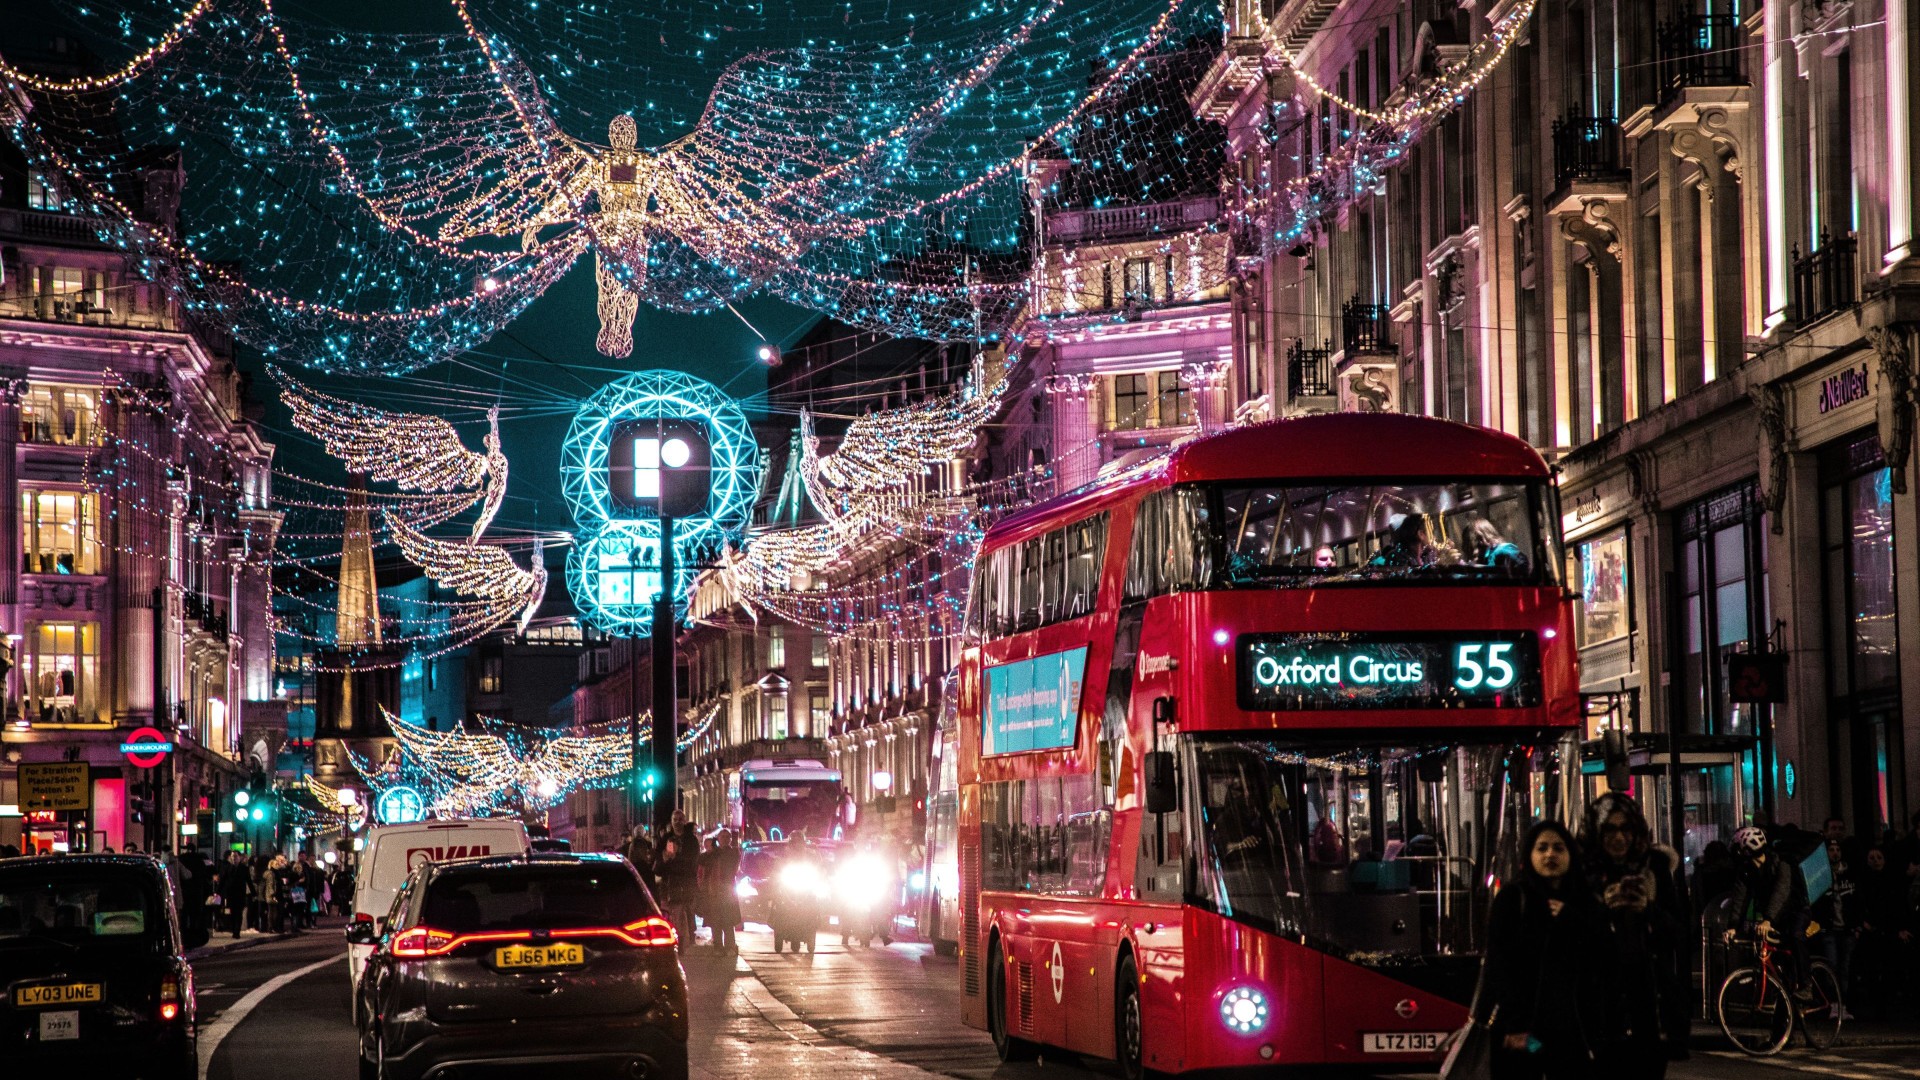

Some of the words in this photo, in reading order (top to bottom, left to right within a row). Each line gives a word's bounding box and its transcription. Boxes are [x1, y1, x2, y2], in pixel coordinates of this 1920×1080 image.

[1826, 363, 1869, 410] NatWest
[1256, 656, 1340, 685] Oxford
[1349, 655, 1423, 684] Circus
[1455, 643, 1513, 689] 55
[42, 766, 82, 775] Stratford
[32, 786, 62, 794] Molton
[65, 785, 75, 793] St
[54, 798, 80, 806] follow
[503, 950, 543, 964] EJ66
[547, 949, 577, 962] MKG
[23, 987, 61, 1002] LY03
[65, 986, 94, 999] UNE
[1375, 1035, 1405, 1049] LTZ
[1408, 1035, 1437, 1049] 1313
